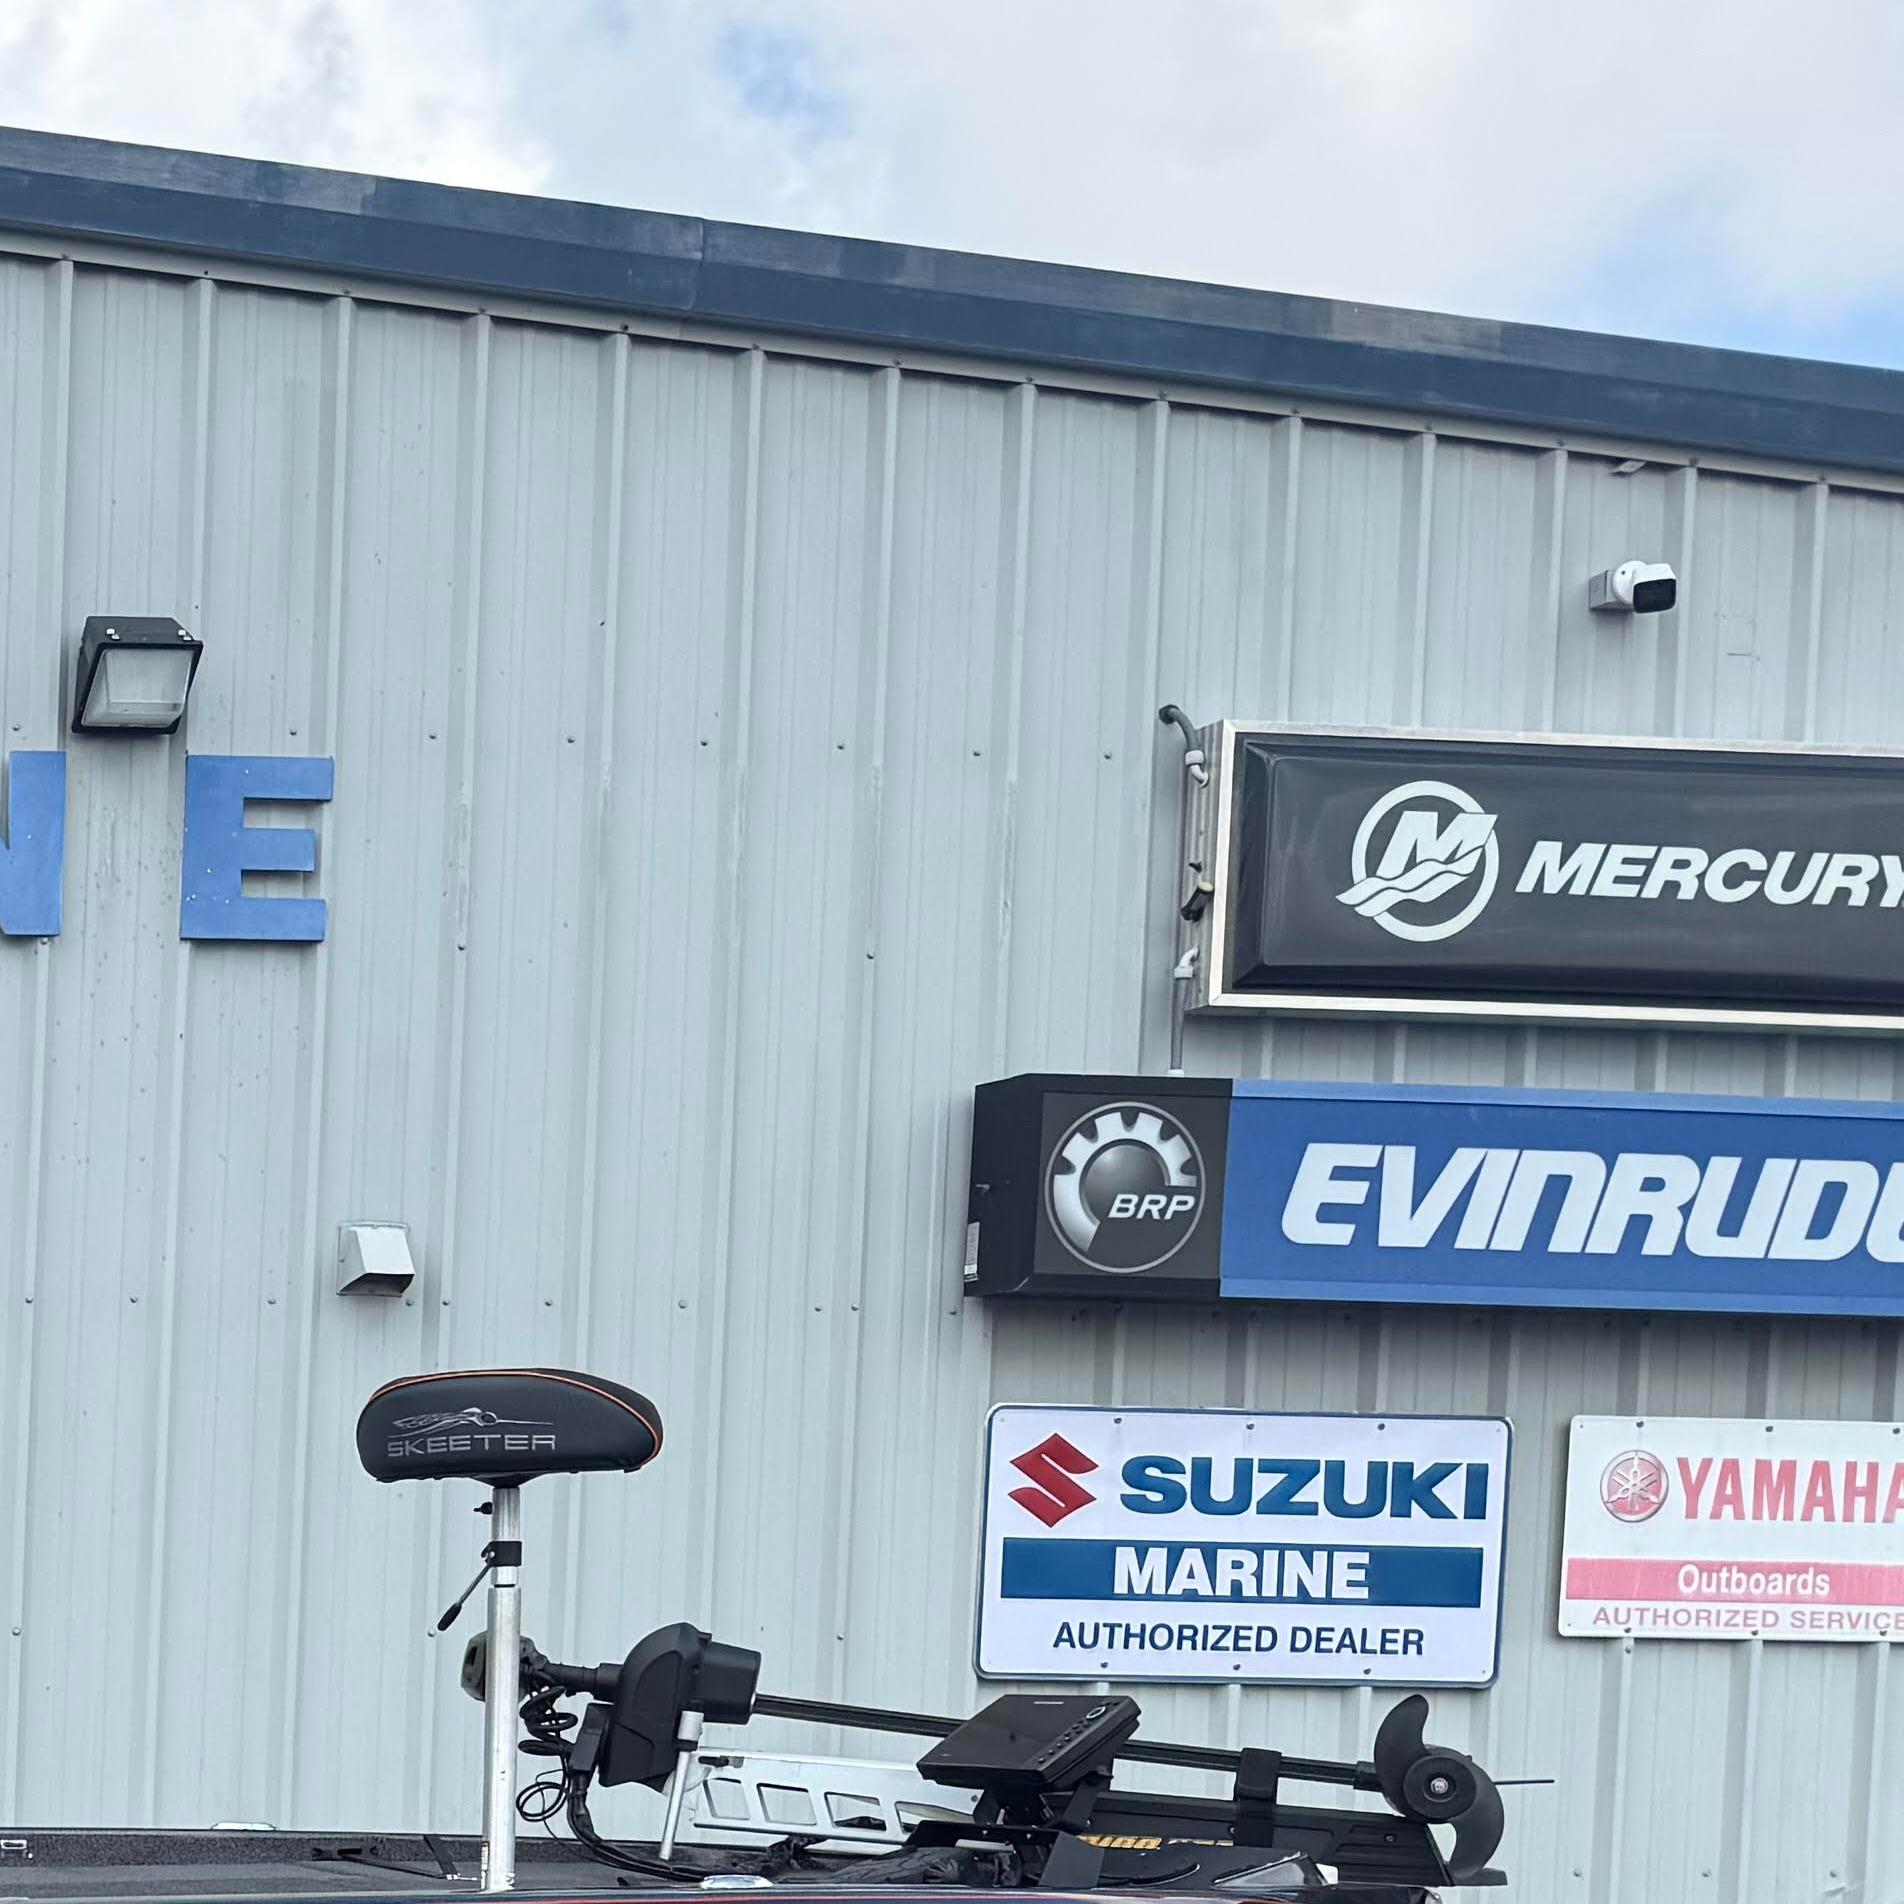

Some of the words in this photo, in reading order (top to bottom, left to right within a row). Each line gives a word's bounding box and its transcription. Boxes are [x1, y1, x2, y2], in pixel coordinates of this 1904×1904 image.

[1107, 1193, 1195, 1221] BRP
[387, 1434, 556, 1457] SKEETER
[1120, 1455, 1489, 1520] SUZUKI
[1677, 1457, 1904, 1524] YAMAHA
[1113, 1546, 1370, 1600] MARINE
[1678, 1564, 1830, 1597] Outboards
[1593, 1607, 1780, 1629] AUTHORIZED
[1053, 1621, 1278, 1653] AUTHORIZED
[1289, 1627, 1424, 1656] DEALER
